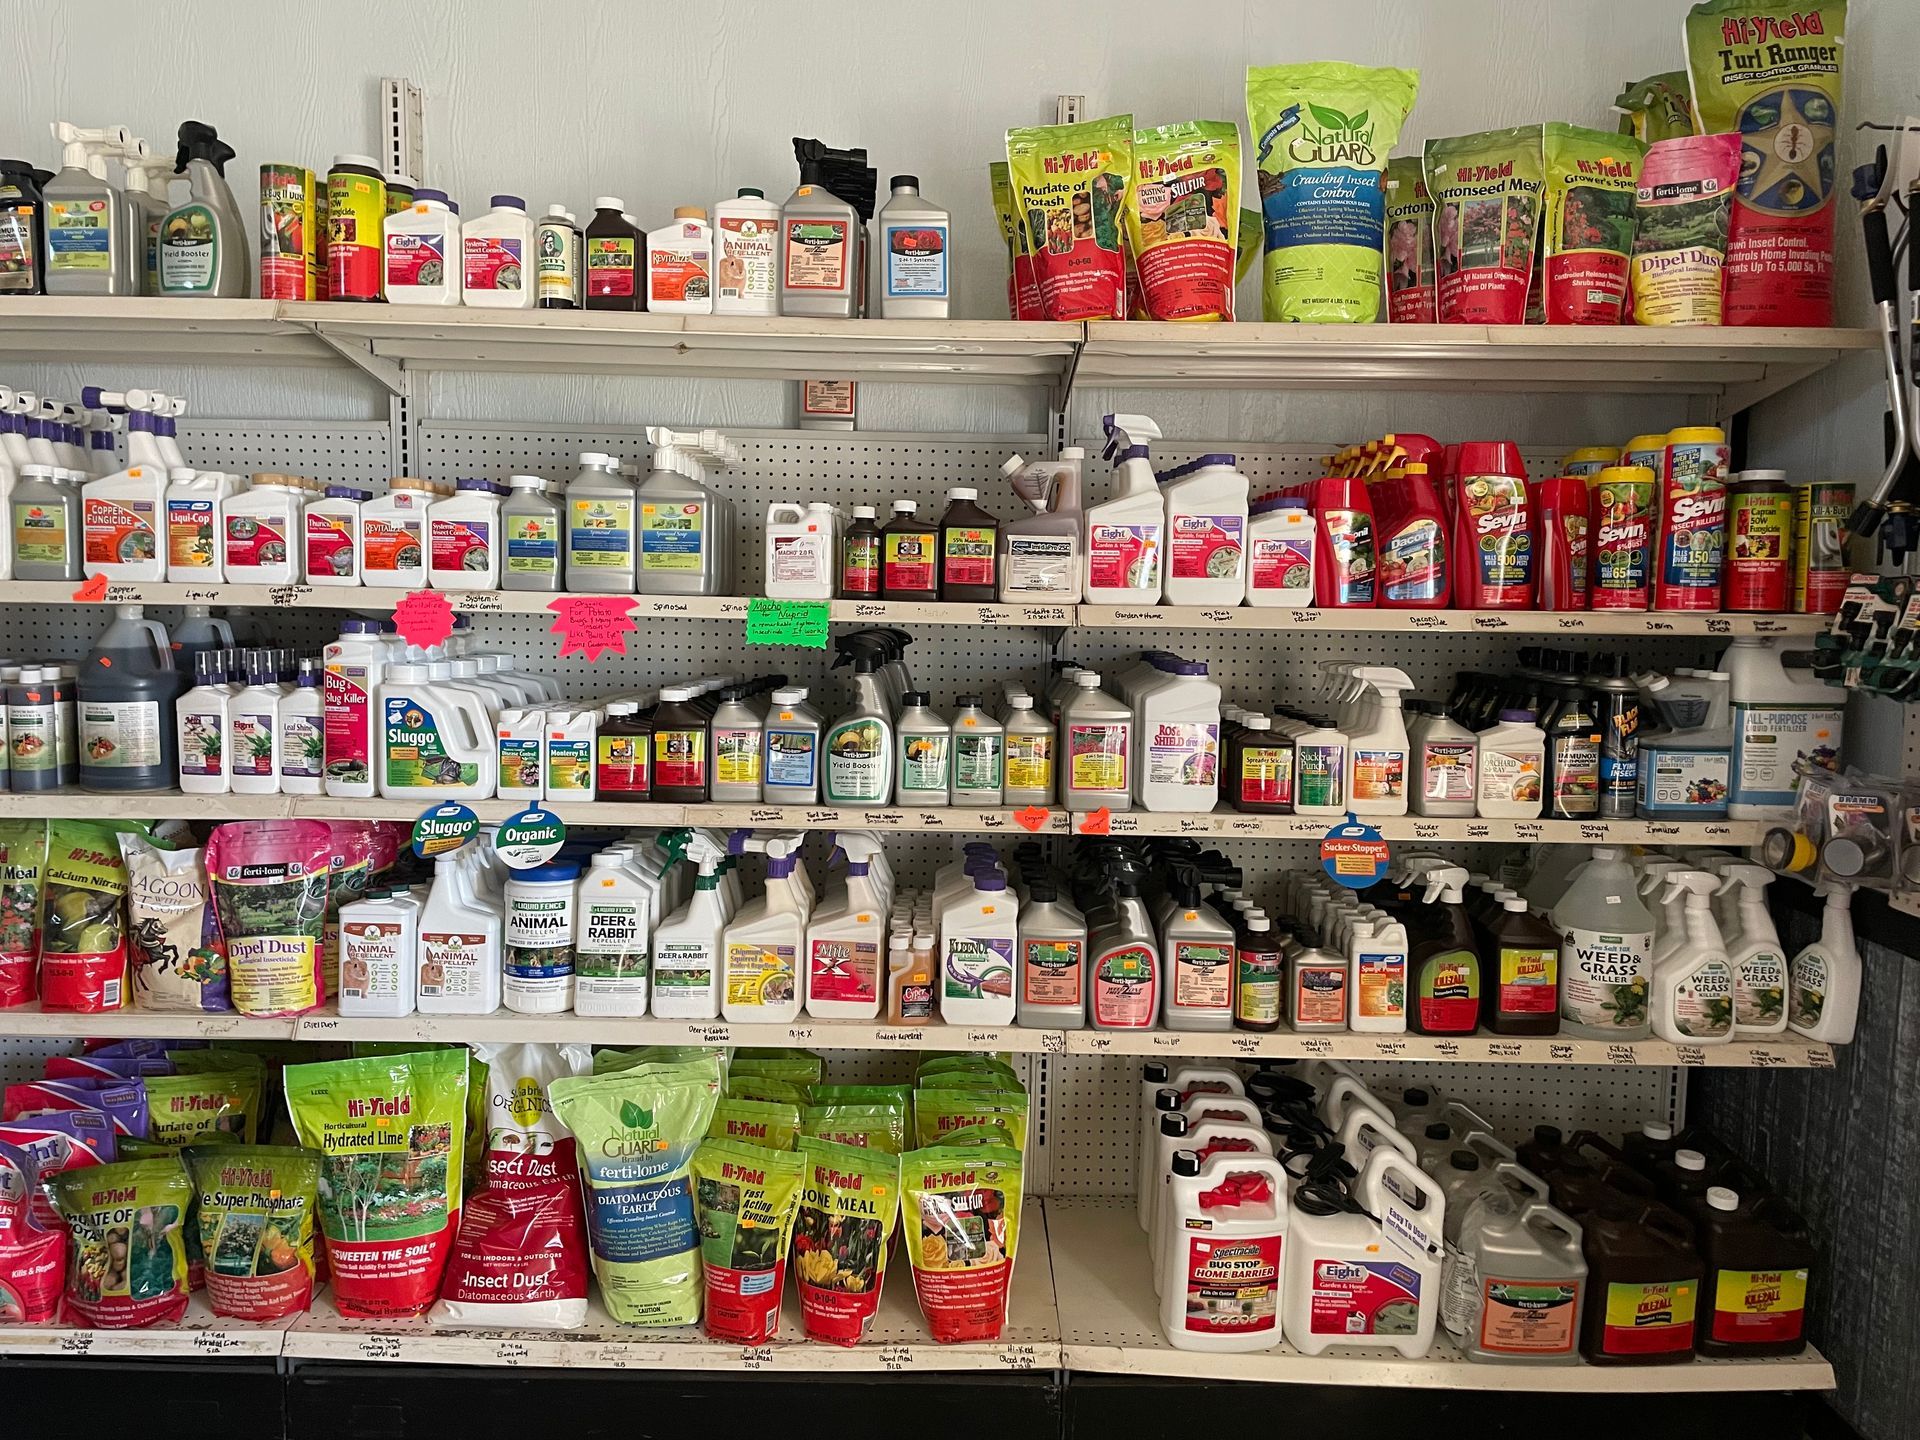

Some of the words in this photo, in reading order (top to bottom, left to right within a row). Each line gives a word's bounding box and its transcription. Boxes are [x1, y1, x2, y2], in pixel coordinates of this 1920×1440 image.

[1722, 11, 1823, 46] Hi-Yield
[1719, 49, 1763, 71] Turf
[1766, 46, 1837, 66] Ranger
[1724, 72, 1754, 84] INSECT
[1756, 67, 1796, 79] CONTROL
[1797, 64, 1838, 73] GRANULES
[1303, 122, 1374, 146] Natural
[1289, 142, 1376, 165] GUARD
[1044, 151, 1098, 175] Hi-Yield
[1139, 156, 1194, 179] Hi-Yield
[1456, 160, 1514, 183] Hi-Yield
[1170, 176, 1207, 199] SULFUR
[1292, 174, 1344, 188] Crawling
[1347, 174, 1376, 187] Insect
[1022, 182, 1070, 197] Muriate
[1073, 181, 1087, 193] of
[1313, 186, 1357, 200] Control
[1656, 184, 1699, 198] ferti-lome
[1024, 195, 1065, 209] Potash
[396, 238, 417, 247] Eight
[726, 242, 773, 254] ANIMAL
[92, 504, 124, 516] COPPER
[1672, 495, 1726, 523] Sevin
[1751, 508, 1776, 517] Captan
[87, 515, 132, 526] FUNGICIDE
[170, 512, 210, 526] Liqui-Cop
[1183, 519, 1206, 529] Eight
[1476, 511, 1527, 534] Sevin
[1750, 517, 1768, 525] 50W
[1101, 528, 1126, 540] Eight
[1598, 524, 1644, 547] Sevin
[1262, 543, 1283, 552] Eight
[1688, 551, 1708, 565] 150
[1612, 568, 1627, 579] 65
[108, 586, 136, 595] Copper
[466, 595, 498, 603] Systemic
[480, 602, 503, 611] Control
[653, 603, 688, 611] Spinosad
[1559, 619, 1584, 628] Sevin
[326, 692, 342, 705] Slug
[343, 692, 366, 704] Killer
[1747, 713, 1808, 725] ALL-PURPOSE
[284, 723, 296, 731] Leaf
[296, 722, 313, 731] Shine
[388, 729, 435, 746] Sluggo
[1154, 735, 1184, 746] SHIELD
[1301, 752, 1327, 762] Sucker
[1301, 760, 1325, 770] Punch
[1838, 796, 1878, 804] DRAMM
[420, 820, 473, 836] Sluggo
[1581, 824, 1610, 832] Orchard
[1705, 826, 1730, 834] Captan
[505, 826, 557, 844] Organic
[1582, 832, 1604, 841] Spray
[1324, 842, 1384, 854] Sucker-Stopper
[68, 848, 122, 868] Hi-Yield
[4, 866, 38, 880] Meal
[243, 866, 286, 876] ferti-lome
[46, 868, 88, 884] Calcium
[91, 876, 128, 892] Nitrate
[517, 902, 539, 911] LIQUID
[540, 901, 564, 910] FENCE
[511, 917, 568, 929] ANIMAL
[591, 915, 627, 927] DEER
[629, 918, 636, 927] &
[588, 928, 637, 939] RABBIT
[230, 940, 264, 957] Dipel
[270, 941, 307, 954] Dust
[348, 945, 396, 954] ANIMAL
[817, 943, 850, 958] Mite
[432, 952, 478, 961] ANIMAL
[658, 952, 678, 960] DEER
[1577, 948, 1632, 964] WEED
[1633, 955, 1641, 964] &
[1580, 962, 1638, 976] GRASS
[1591, 975, 1627, 983] KILLER
[1743, 974, 1780, 983] GRASS
[1694, 984, 1729, 992] GRASS
[968, 1032, 986, 1041] Liquid
[170, 1094, 225, 1112] Hi-Yield
[347, 1094, 412, 1119] Hi-Yield
[324, 1121, 367, 1131] Horticultural
[609, 1121, 661, 1142] Natural
[726, 1120, 768, 1138] Hi-Yield
[323, 1130, 375, 1149] Hydrated
[378, 1130, 404, 1147] Lime
[602, 1136, 662, 1159] GUARD
[621, 1154, 644, 1164] Brand
[645, 1154, 654, 1164] by
[600, 1160, 669, 1179] ferti-lome
[721, 1162, 767, 1186] Hi-Yield
[221, 1167, 274, 1189] Hi-Yield
[813, 1166, 864, 1191] Hi-Yield
[922, 1170, 977, 1190] Hi-Yield
[597, 1186, 681, 1206] DIATOMACEOUS
[743, 1189, 764, 1199] Fast
[622, 1202, 657, 1215] EARTH
[742, 1199, 773, 1214] Acting
[951, 1192, 985, 1212] SULFUR
[1389, 1207, 1404, 1223] Easy
[1404, 1217, 1412, 1230] To
[1412, 1225, 1428, 1243] Use!
[524, 1252, 563, 1261] OUTDOORS
[1212, 1247, 1261, 1260] Spectracide
[1209, 1260, 1232, 1271] BUG
[1233, 1260, 1261, 1270] STOP
[1194, 1268, 1230, 1279] HOME
[1230, 1266, 1275, 1279] BARRIER
[1326, 1265, 1362, 1280] Eight
[465, 1271, 509, 1288] Insect
[512, 1271, 550, 1288] Dust
[1319, 1281, 1341, 1291] Garden
[1349, 1283, 1368, 1291] Home
[458, 1288, 525, 1302] Diatomaceous
[529, 1288, 555, 1301] Earth
[637, 1306, 662, 1315] CAUTION
